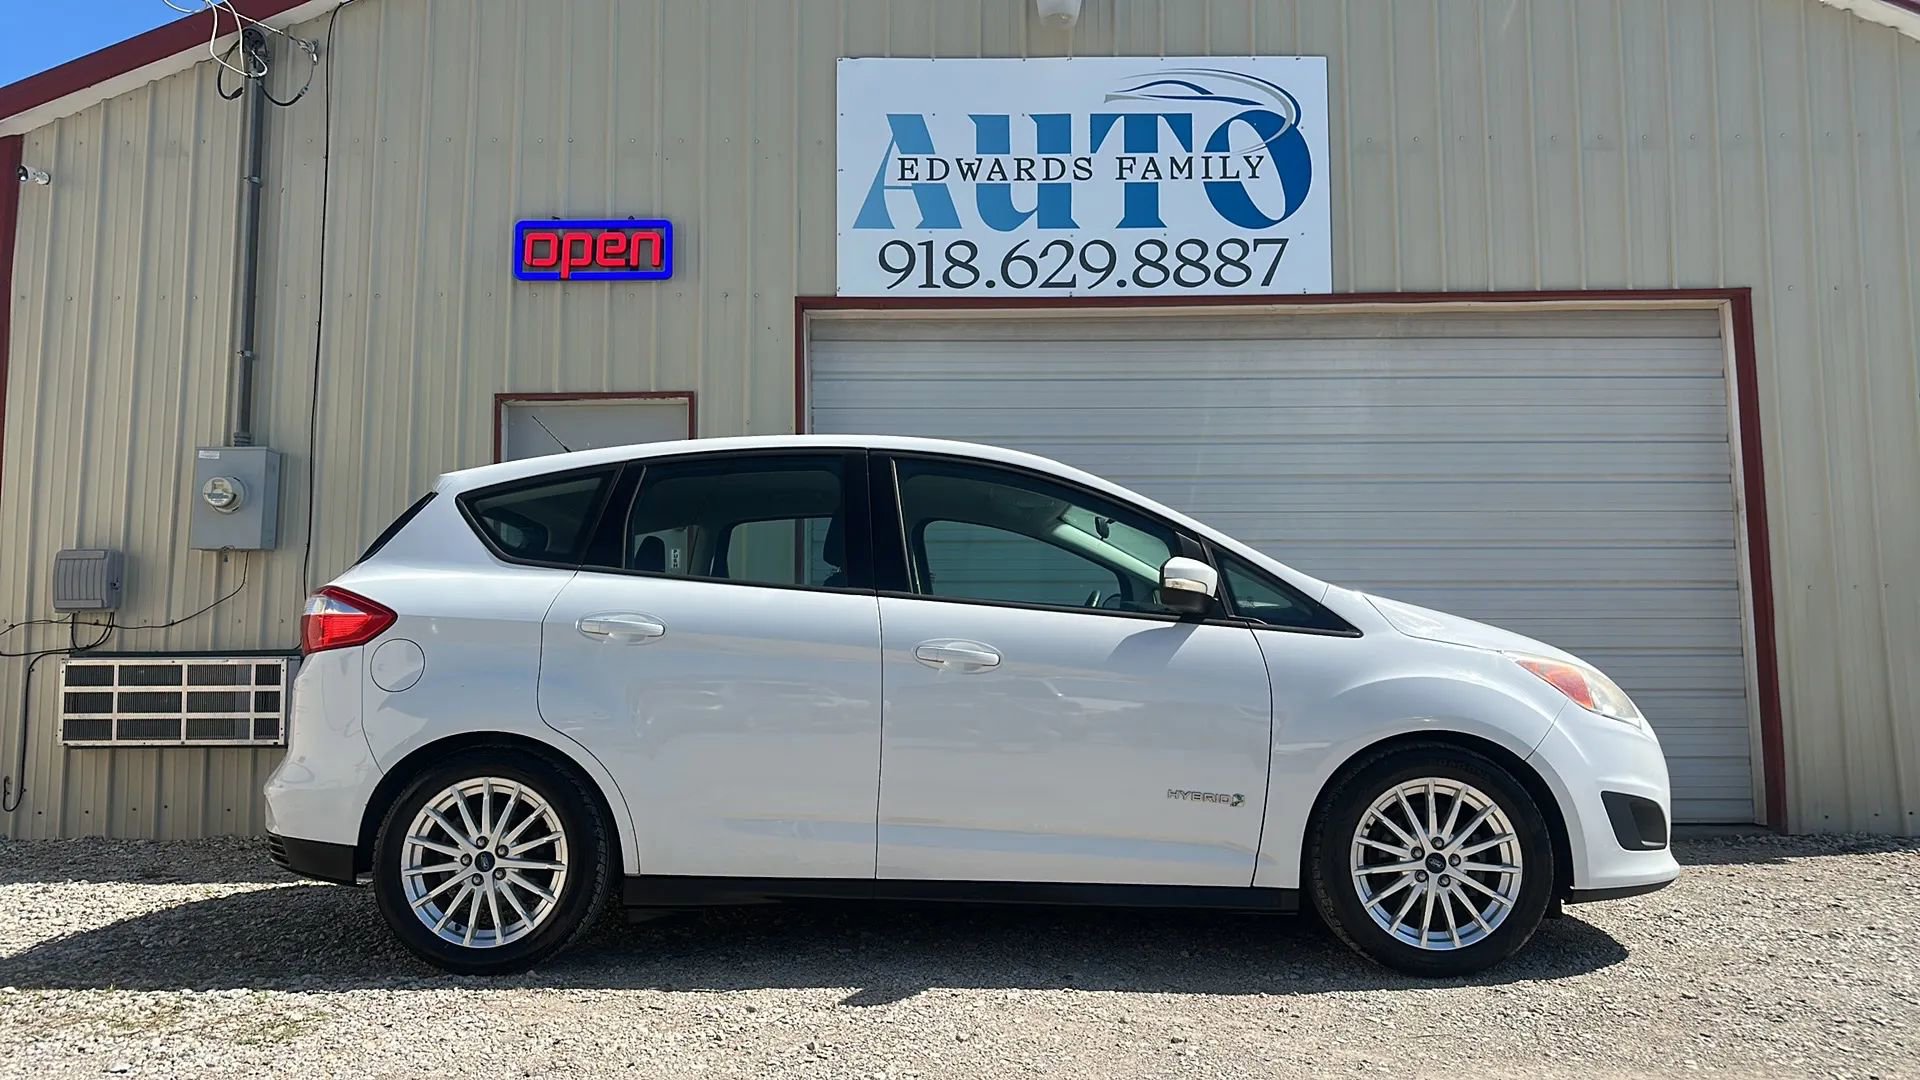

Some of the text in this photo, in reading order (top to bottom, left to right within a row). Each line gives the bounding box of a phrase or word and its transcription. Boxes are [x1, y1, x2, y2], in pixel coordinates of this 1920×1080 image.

[852, 109, 1312, 232] AUTO
[897, 155, 1265, 182] EDWARDS FAMILY
[524, 231, 661, 281] open
[878, 238, 1290, 290] 918.629.8887
[1167, 789, 1231, 805] HYBRID
